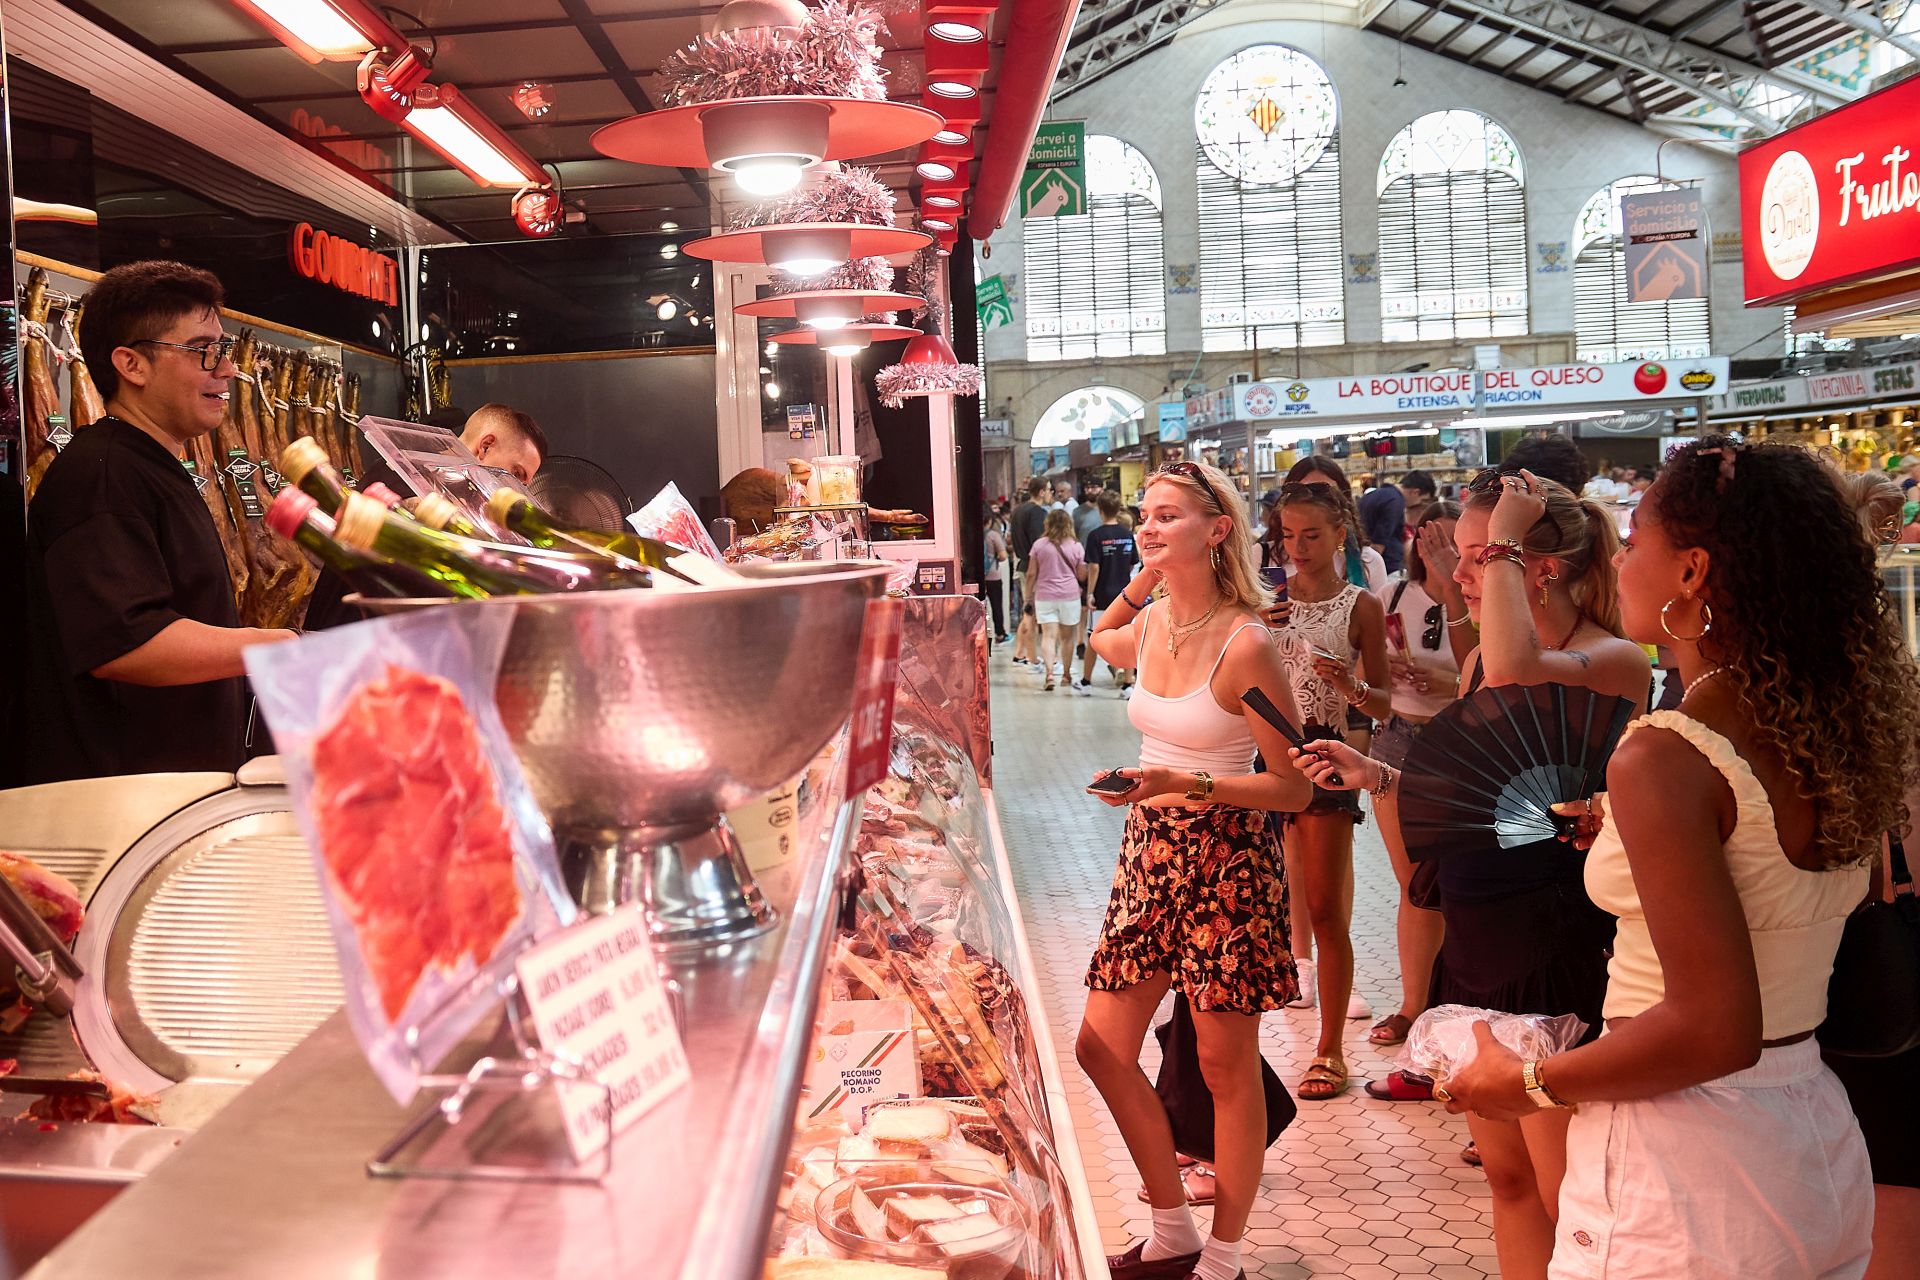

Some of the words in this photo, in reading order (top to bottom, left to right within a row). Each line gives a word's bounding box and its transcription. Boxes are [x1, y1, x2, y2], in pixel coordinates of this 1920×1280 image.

[1029, 145, 1077, 159] domicili
[1835, 145, 1920, 227] Fruto
[1626, 201, 1686, 218] Servicio
[1690, 202, 1698, 212] a
[1629, 216, 1698, 235] domicilio
[293, 222, 398, 307] GOURMET
[1338, 381, 1363, 398] LA
[1371, 374, 1471, 396] BOUTIQUE
[1485, 371, 1519, 389] DEL
[1531, 366, 1604, 387] QUESO
[1809, 374, 1866, 399] VIRGINIA
[1874, 366, 1915, 392] SETAS
[1398, 395, 1460, 409] EXTENSA
[1467, 389, 1542, 405] VRIACION
[1734, 385, 1787, 408] VERDURAS
[841, 1069, 881, 1078] PECORINO
[843, 1078, 880, 1086] ROMANO
[850, 1086, 874, 1094] D.O.P.
